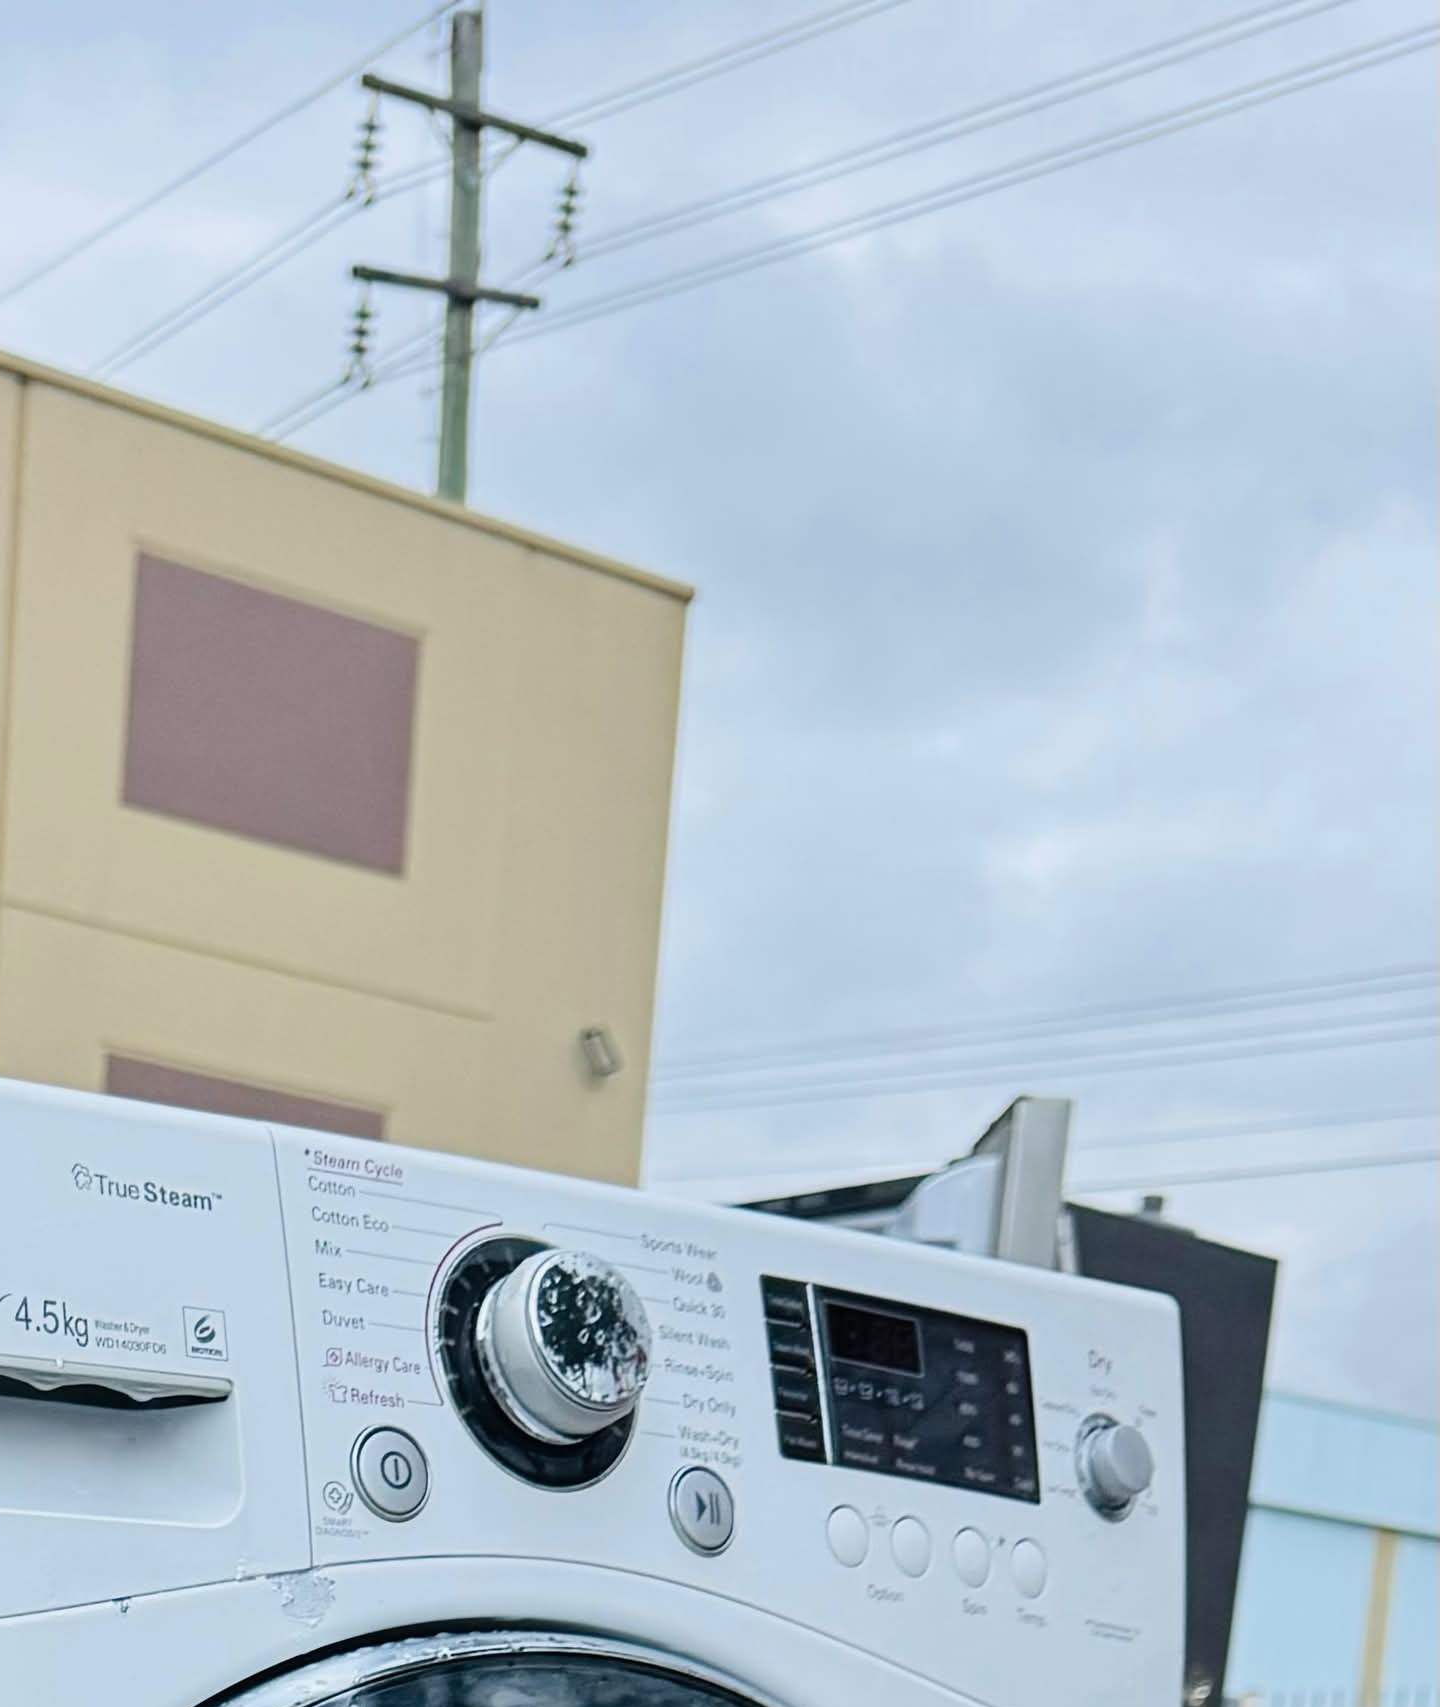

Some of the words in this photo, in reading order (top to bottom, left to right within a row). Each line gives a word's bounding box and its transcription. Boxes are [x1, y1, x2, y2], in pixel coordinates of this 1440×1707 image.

[313, 1150, 360, 1171] Steam
[364, 1159, 403, 1178] Cycle
[308, 1175, 355, 1197] Cotton
[312, 1206, 359, 1227] Cotton
[363, 1214, 389, 1232] Eco
[315, 1239, 342, 1257] Mix
[318, 1272, 352, 1294] Easy
[356, 1278, 389, 1297] Care
[322, 1309, 365, 1330] Duvet
[345, 1351, 389, 1374] Allergy
[392, 1356, 421, 1375] Care
[350, 1387, 405, 1408] Refresh
